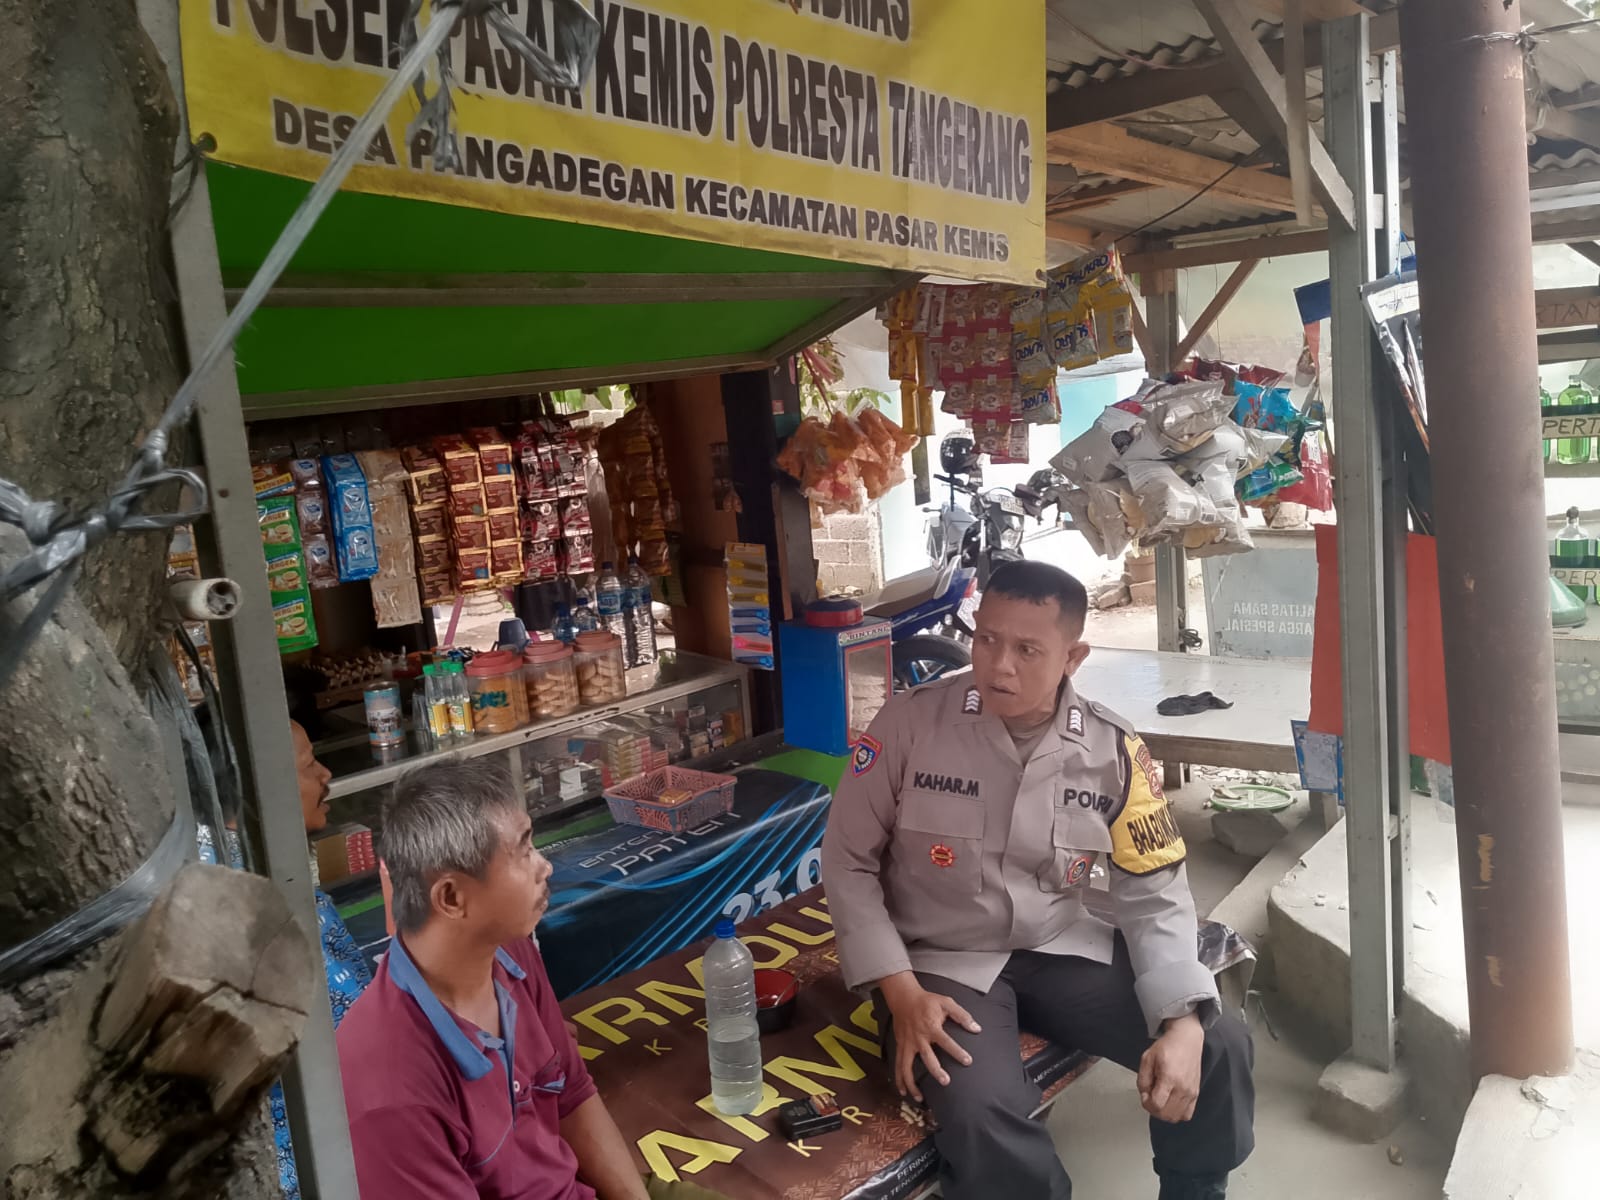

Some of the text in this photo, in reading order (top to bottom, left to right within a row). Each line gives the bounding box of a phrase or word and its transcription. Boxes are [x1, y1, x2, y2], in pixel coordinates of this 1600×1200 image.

[596, 0, 715, 137] KEMIS
[723, 35, 881, 172] POLRESTA
[888, 80, 1031, 205] TANGERANG
[273, 99, 1010, 263] DESA PNGADEGAN KECAMATAN PASAR KEMIS
[1542, 417, 1600, 436] PERT
[1554, 570, 1600, 586] PER
[913, 772, 980, 797] KAHAR.M
[1063, 787, 1114, 815] POLRI
